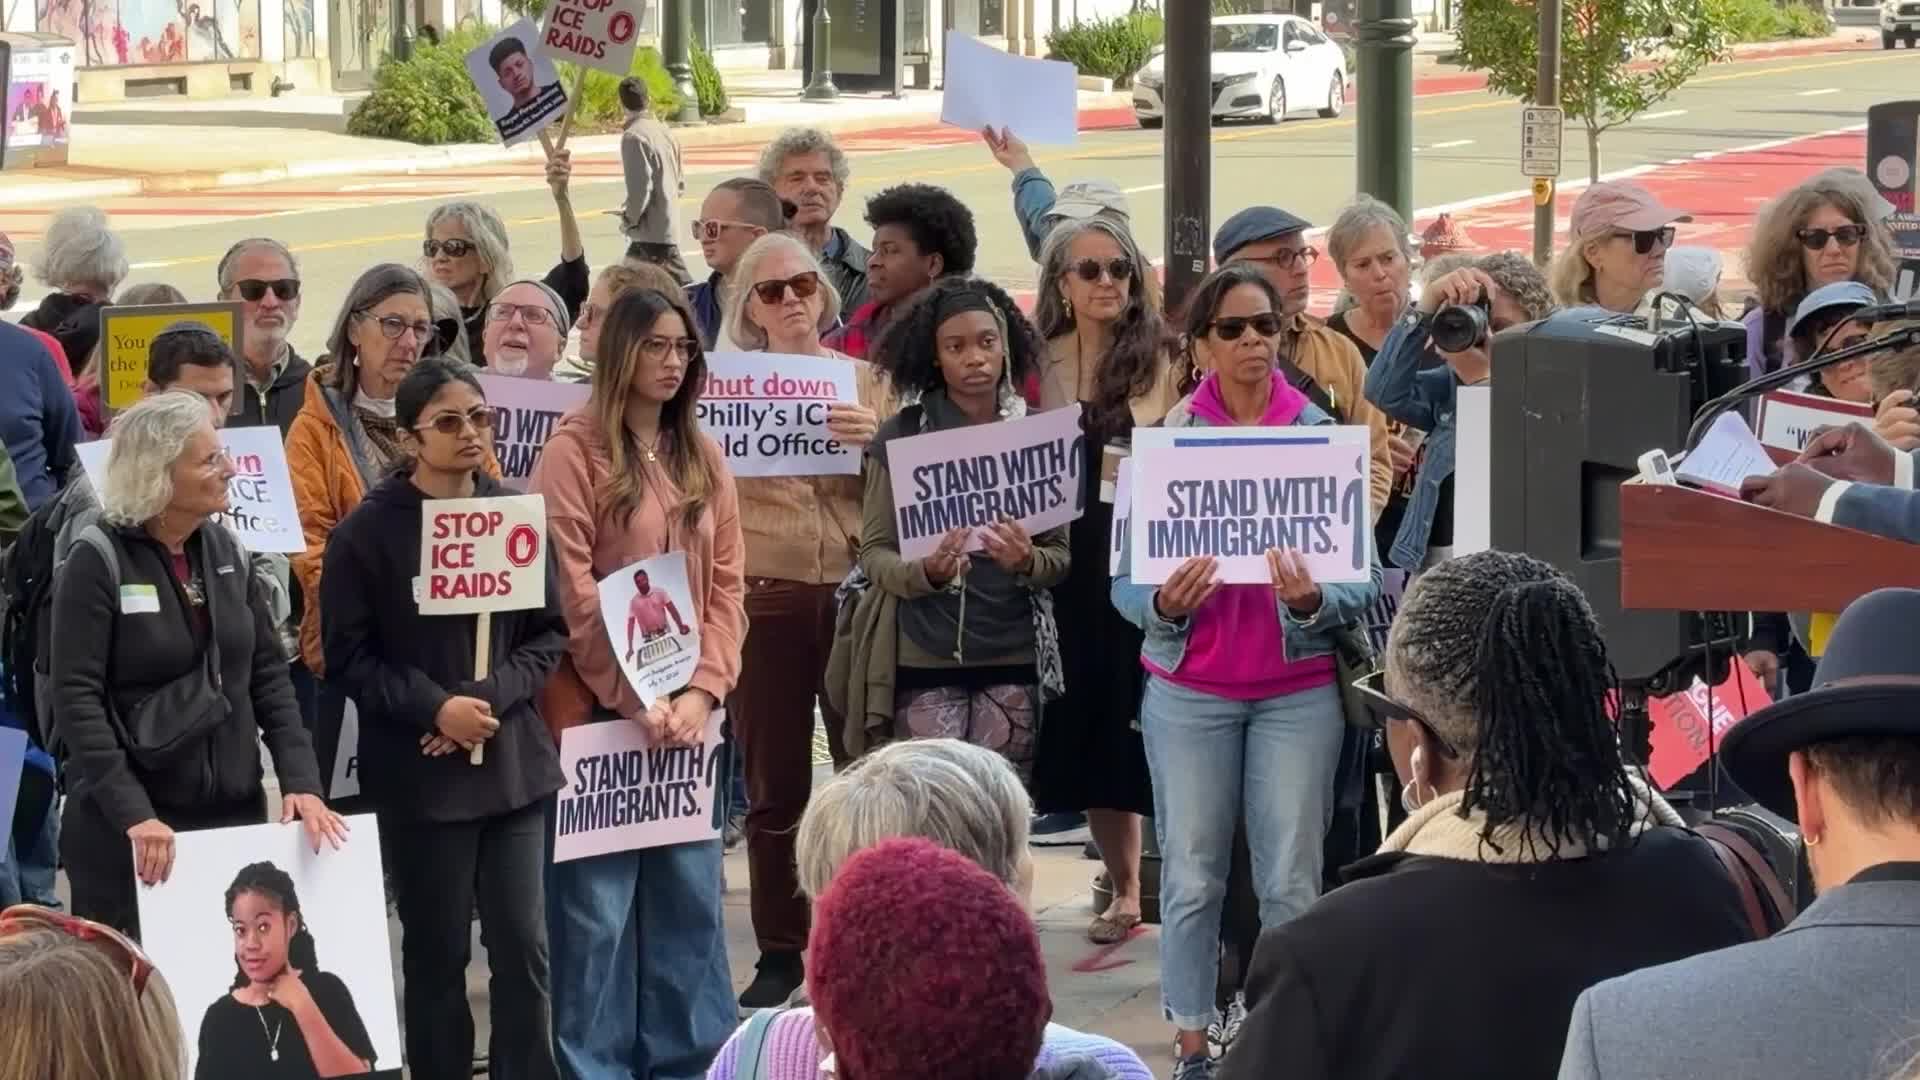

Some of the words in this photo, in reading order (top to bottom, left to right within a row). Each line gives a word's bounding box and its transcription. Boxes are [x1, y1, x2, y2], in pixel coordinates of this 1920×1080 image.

[552, 5, 586, 30] ICE
[546, 27, 607, 59] RAIDS
[114, 335, 145, 350] You
[111, 355, 137, 372] the
[702, 371, 755, 396] hut
[763, 372, 838, 396] down
[797, 403, 833, 426] IC
[757, 433, 848, 457] Office.
[912, 455, 999, 502] STAND
[1001, 438, 1066, 486] WITH
[229, 479, 272, 503] ICE
[1167, 478, 1258, 518] STAND
[1263, 476, 1337, 516] WITH
[900, 474, 1067, 540] IMMIGRANTS.
[432, 511, 504, 539] STOP
[1148, 515, 1339, 558] IMMIGRANTS.
[431, 543, 475, 570] ICE
[430, 570, 512, 600] RAIDS
[574, 751, 642, 796] STAND
[648, 742, 704, 784] WITH
[559, 780, 702, 837] IMMIGRANTS.
